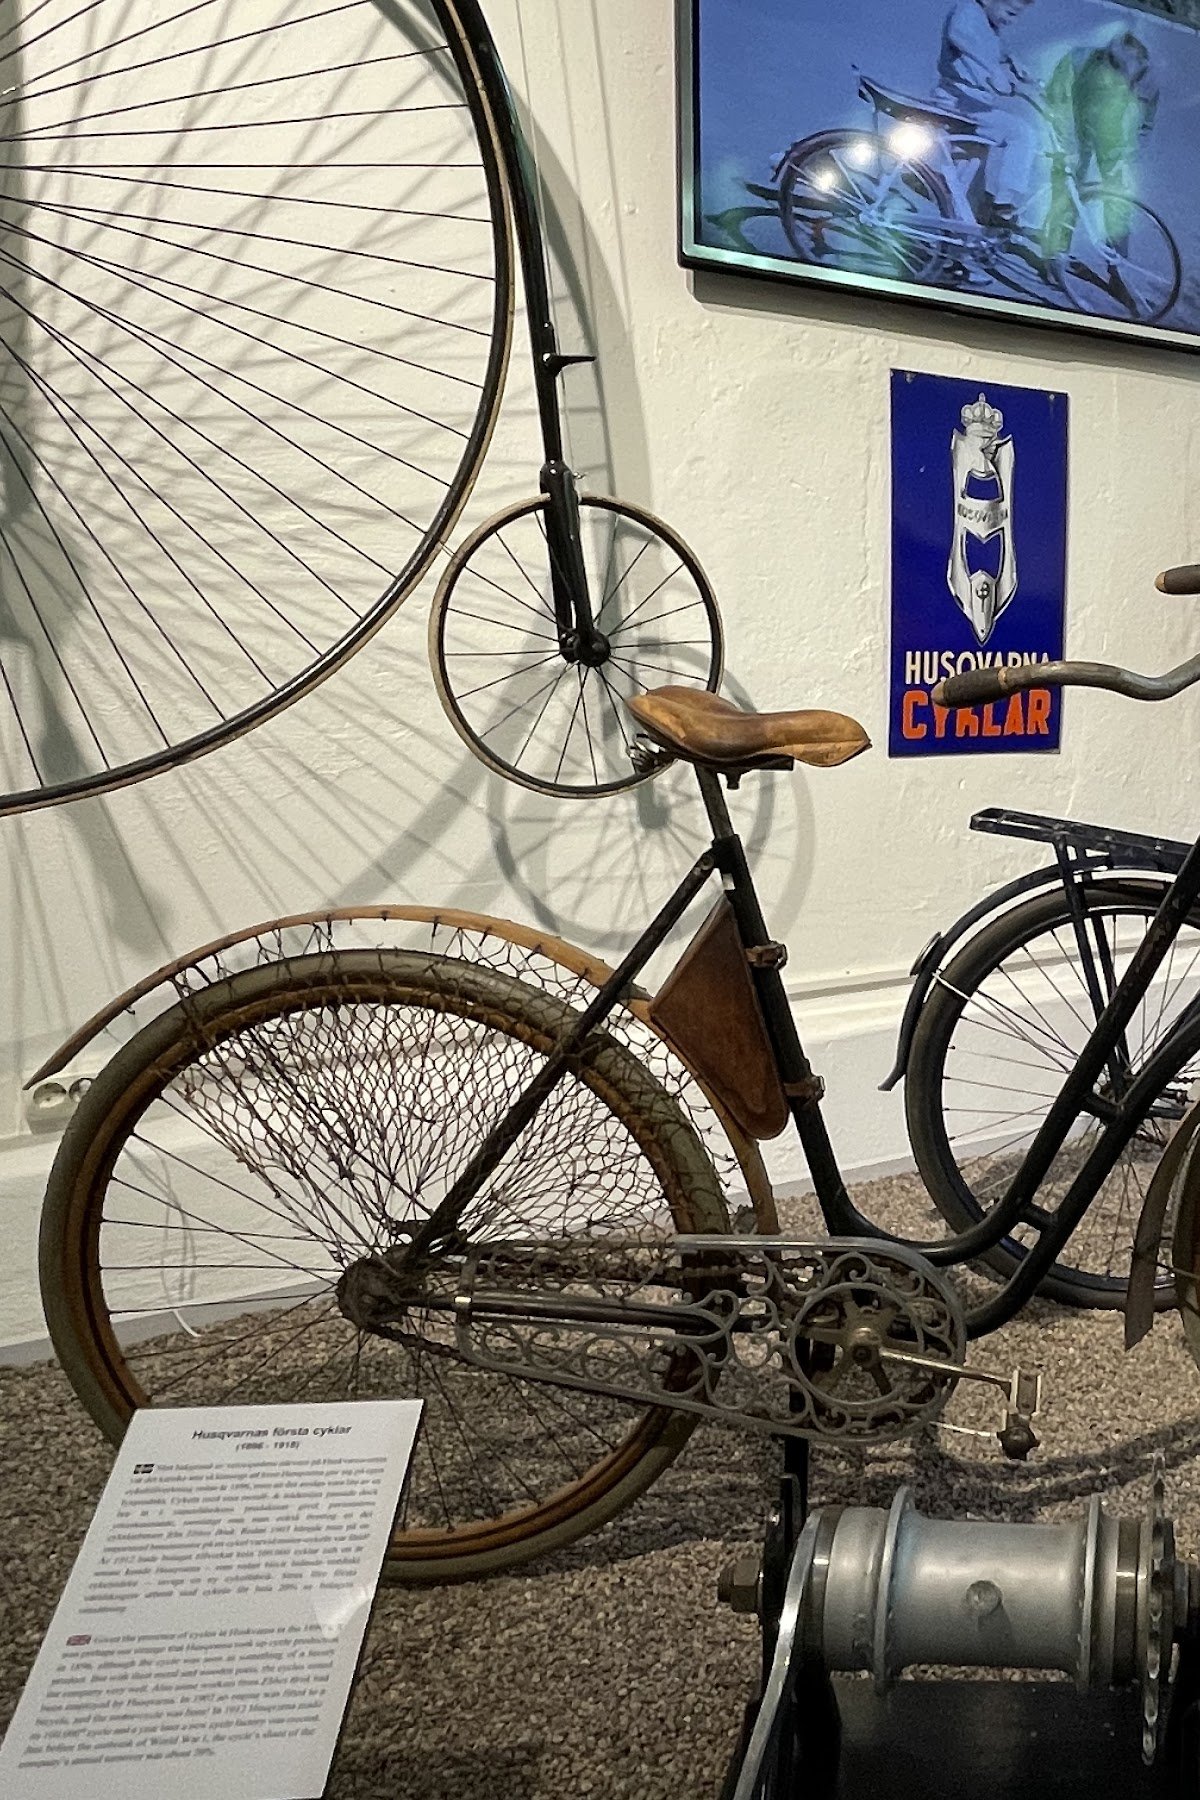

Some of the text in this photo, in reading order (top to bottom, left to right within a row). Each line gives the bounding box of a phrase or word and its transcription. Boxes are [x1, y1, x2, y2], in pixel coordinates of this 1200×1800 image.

[192, 1425, 352, 1440] Husqvarnas första cyklar
